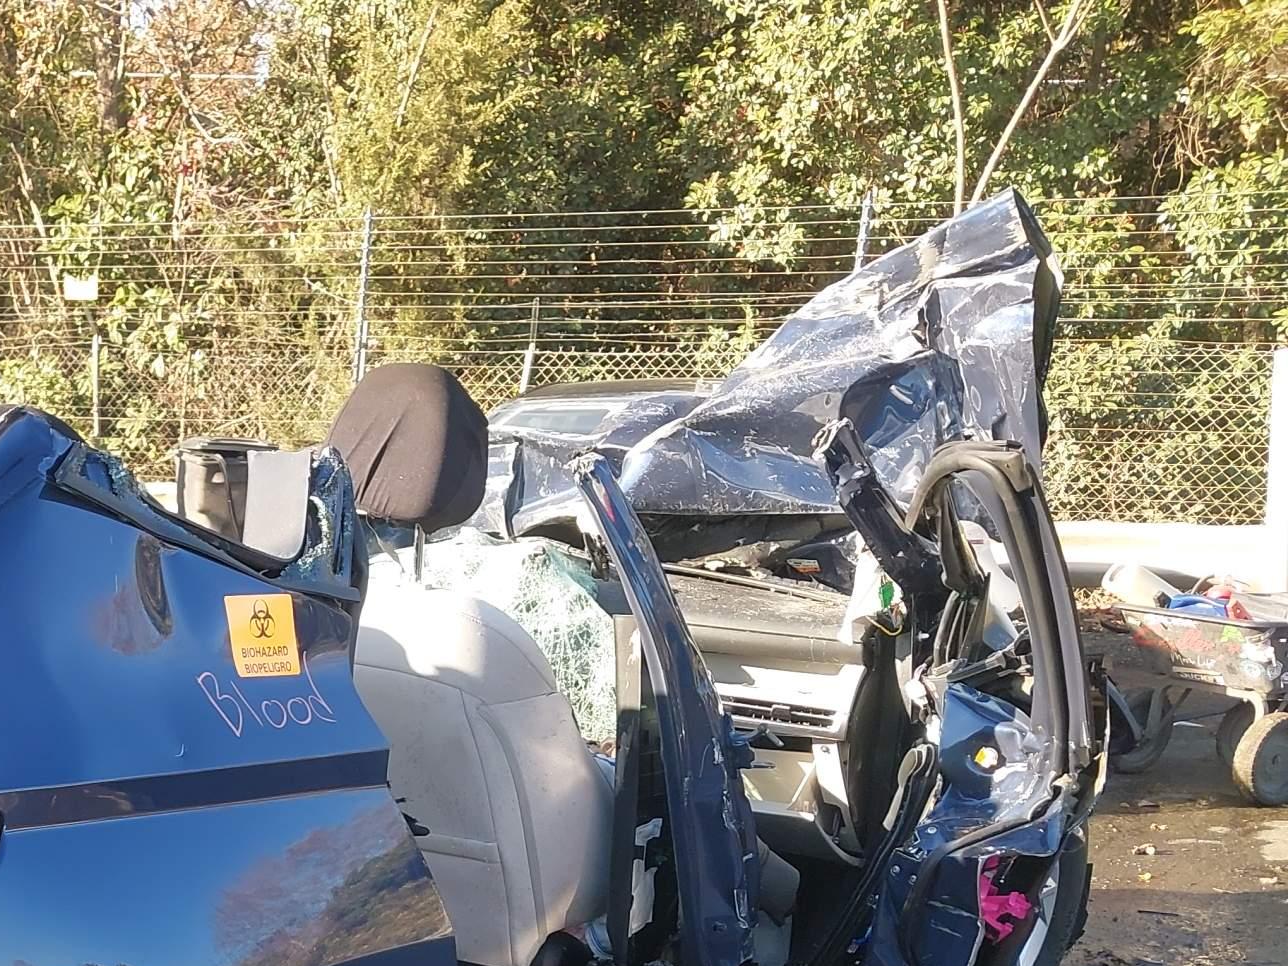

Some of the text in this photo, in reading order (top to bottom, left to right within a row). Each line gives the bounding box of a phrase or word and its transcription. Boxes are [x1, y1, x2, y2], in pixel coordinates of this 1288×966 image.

[241, 645, 289, 658] BIOHAZARD
[244, 660, 292, 674] BIOPELIGRO
[197, 651, 337, 737] Blood
